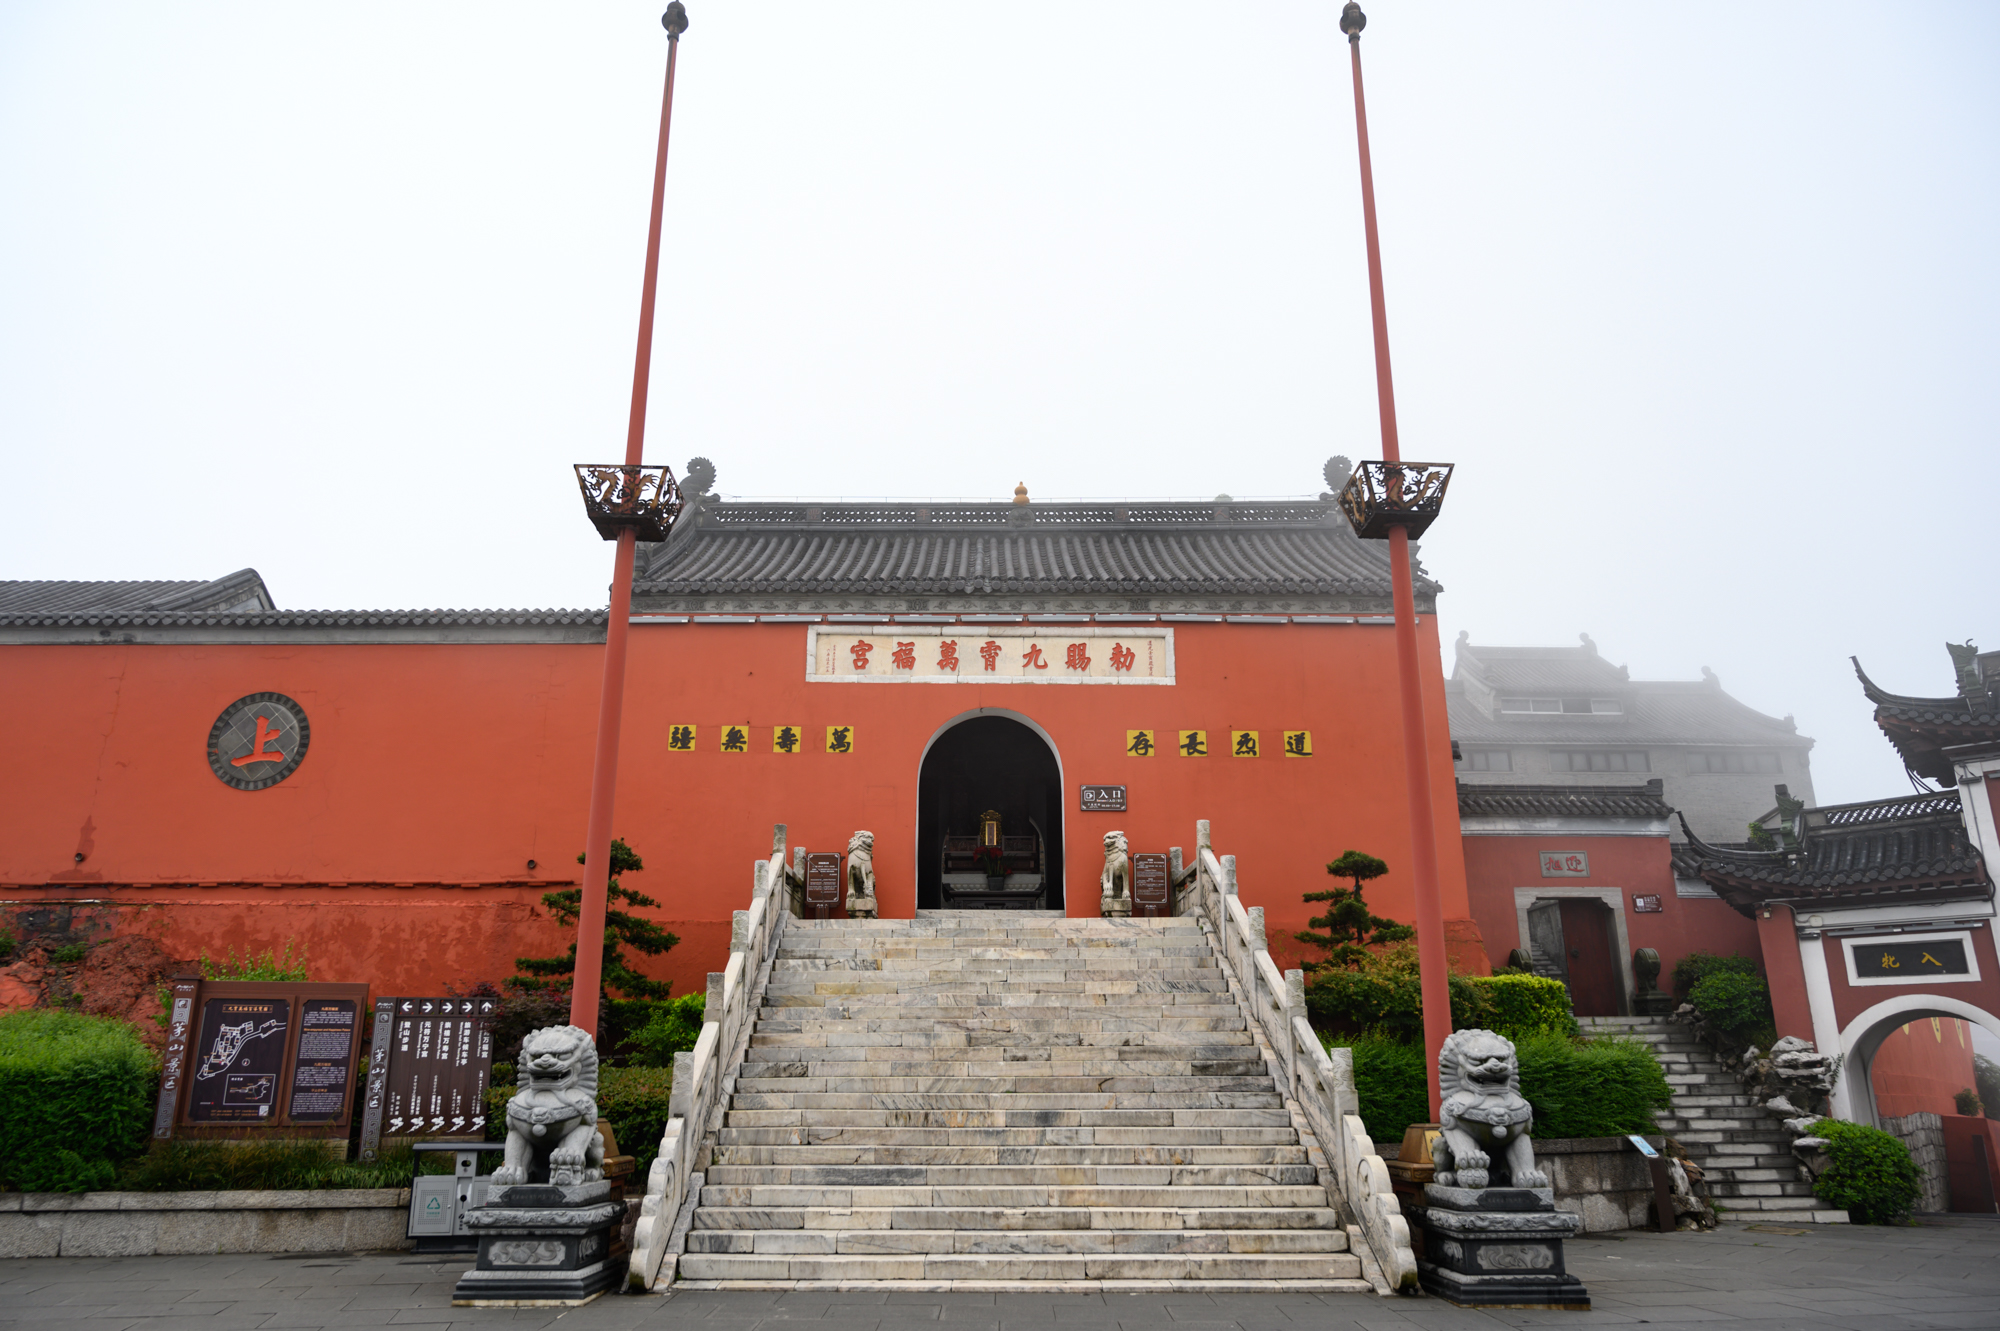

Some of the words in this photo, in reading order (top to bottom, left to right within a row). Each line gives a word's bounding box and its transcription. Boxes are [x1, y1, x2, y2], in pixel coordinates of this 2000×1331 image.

[230, 715, 284, 767] 上
[1098, 789, 1121, 799] 入口
[164, 1022, 185, 1090] 茅山景区
[369, 1049, 386, 1108] 茅山景区
